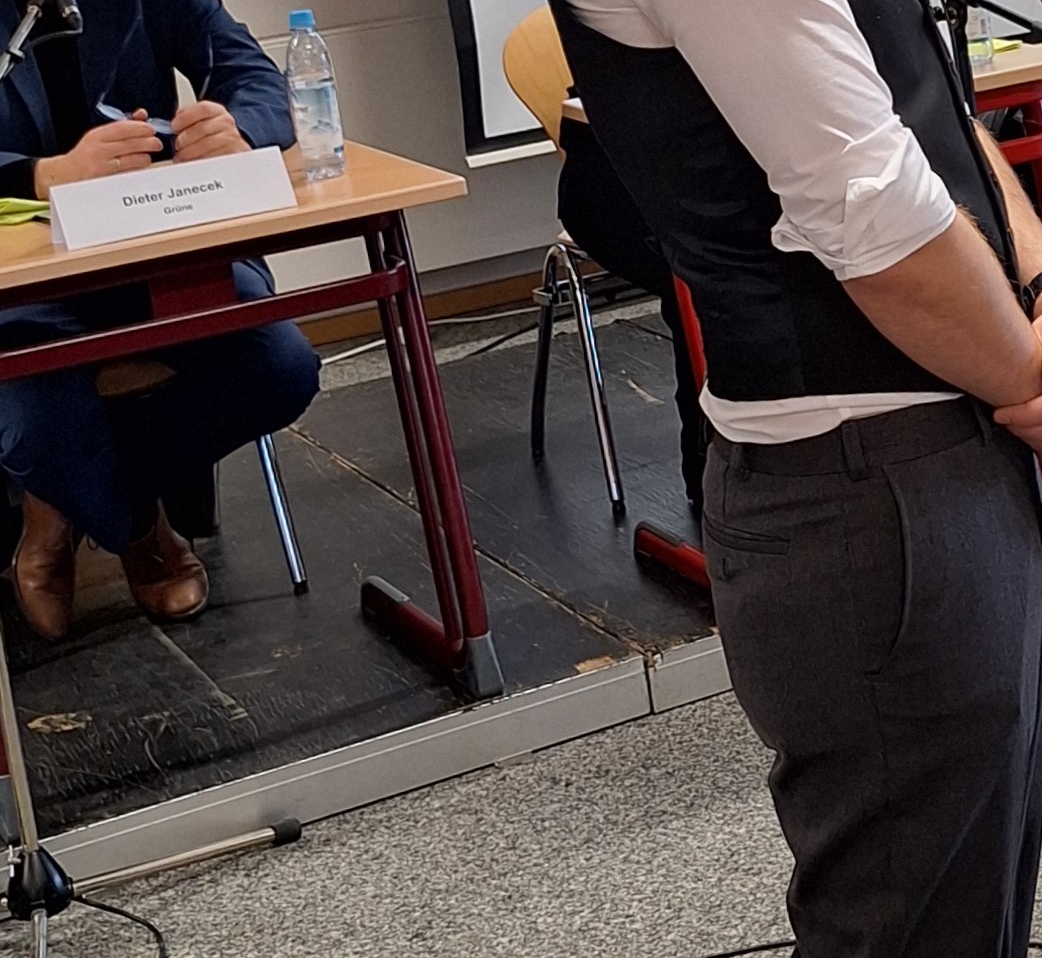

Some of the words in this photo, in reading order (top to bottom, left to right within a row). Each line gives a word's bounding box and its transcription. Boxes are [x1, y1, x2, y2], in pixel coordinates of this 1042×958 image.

[122, 191, 164, 207] Dieter
[167, 180, 224, 198] Janecek
[164, 203, 194, 214] Grüne
